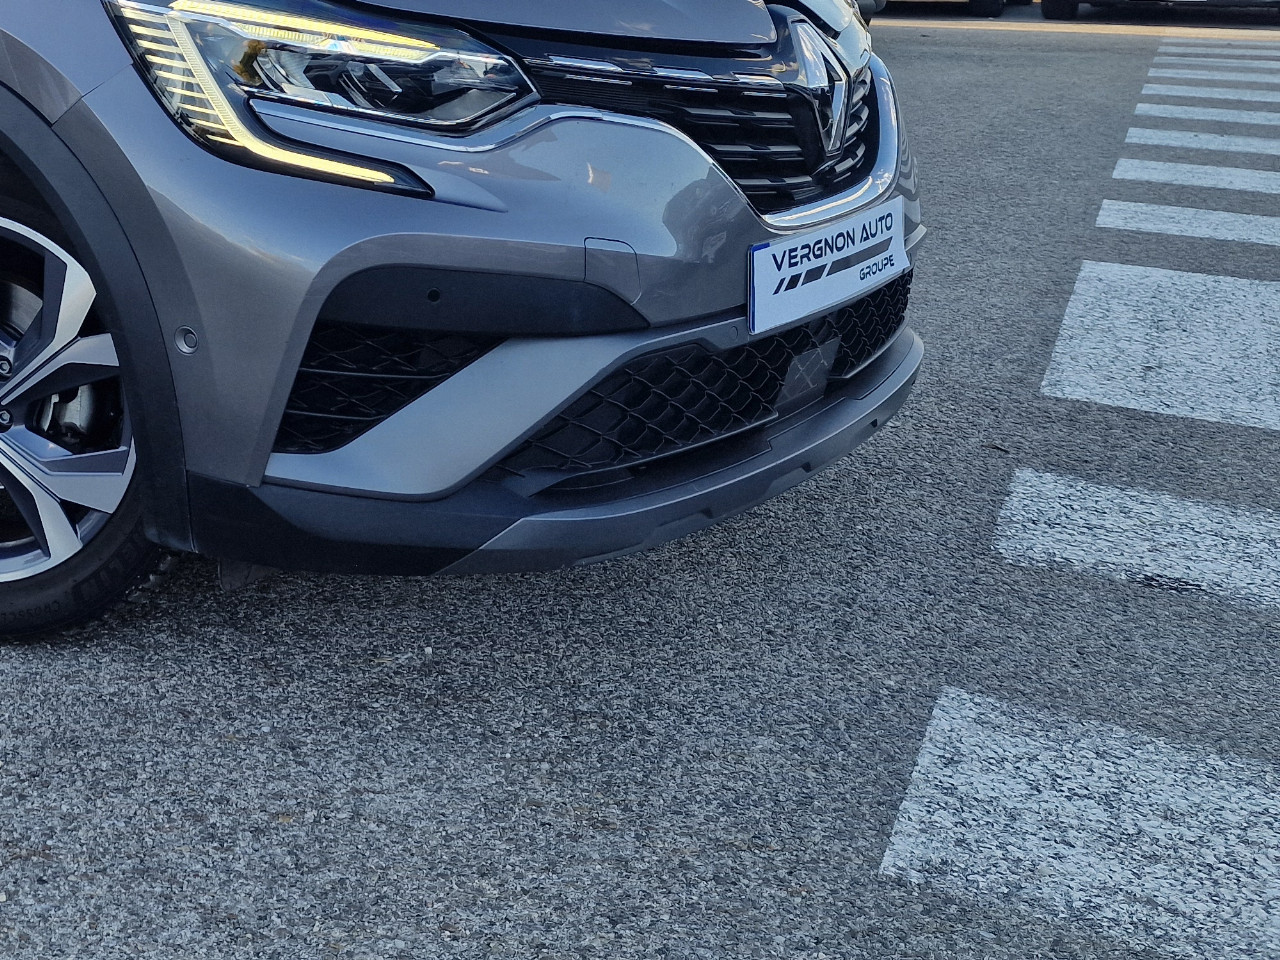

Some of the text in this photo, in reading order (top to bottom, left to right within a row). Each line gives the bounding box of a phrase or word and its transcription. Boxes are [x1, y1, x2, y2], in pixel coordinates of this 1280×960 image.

[771, 212, 894, 272] VERGNON AUTO
[859, 254, 895, 281] GROUPE
